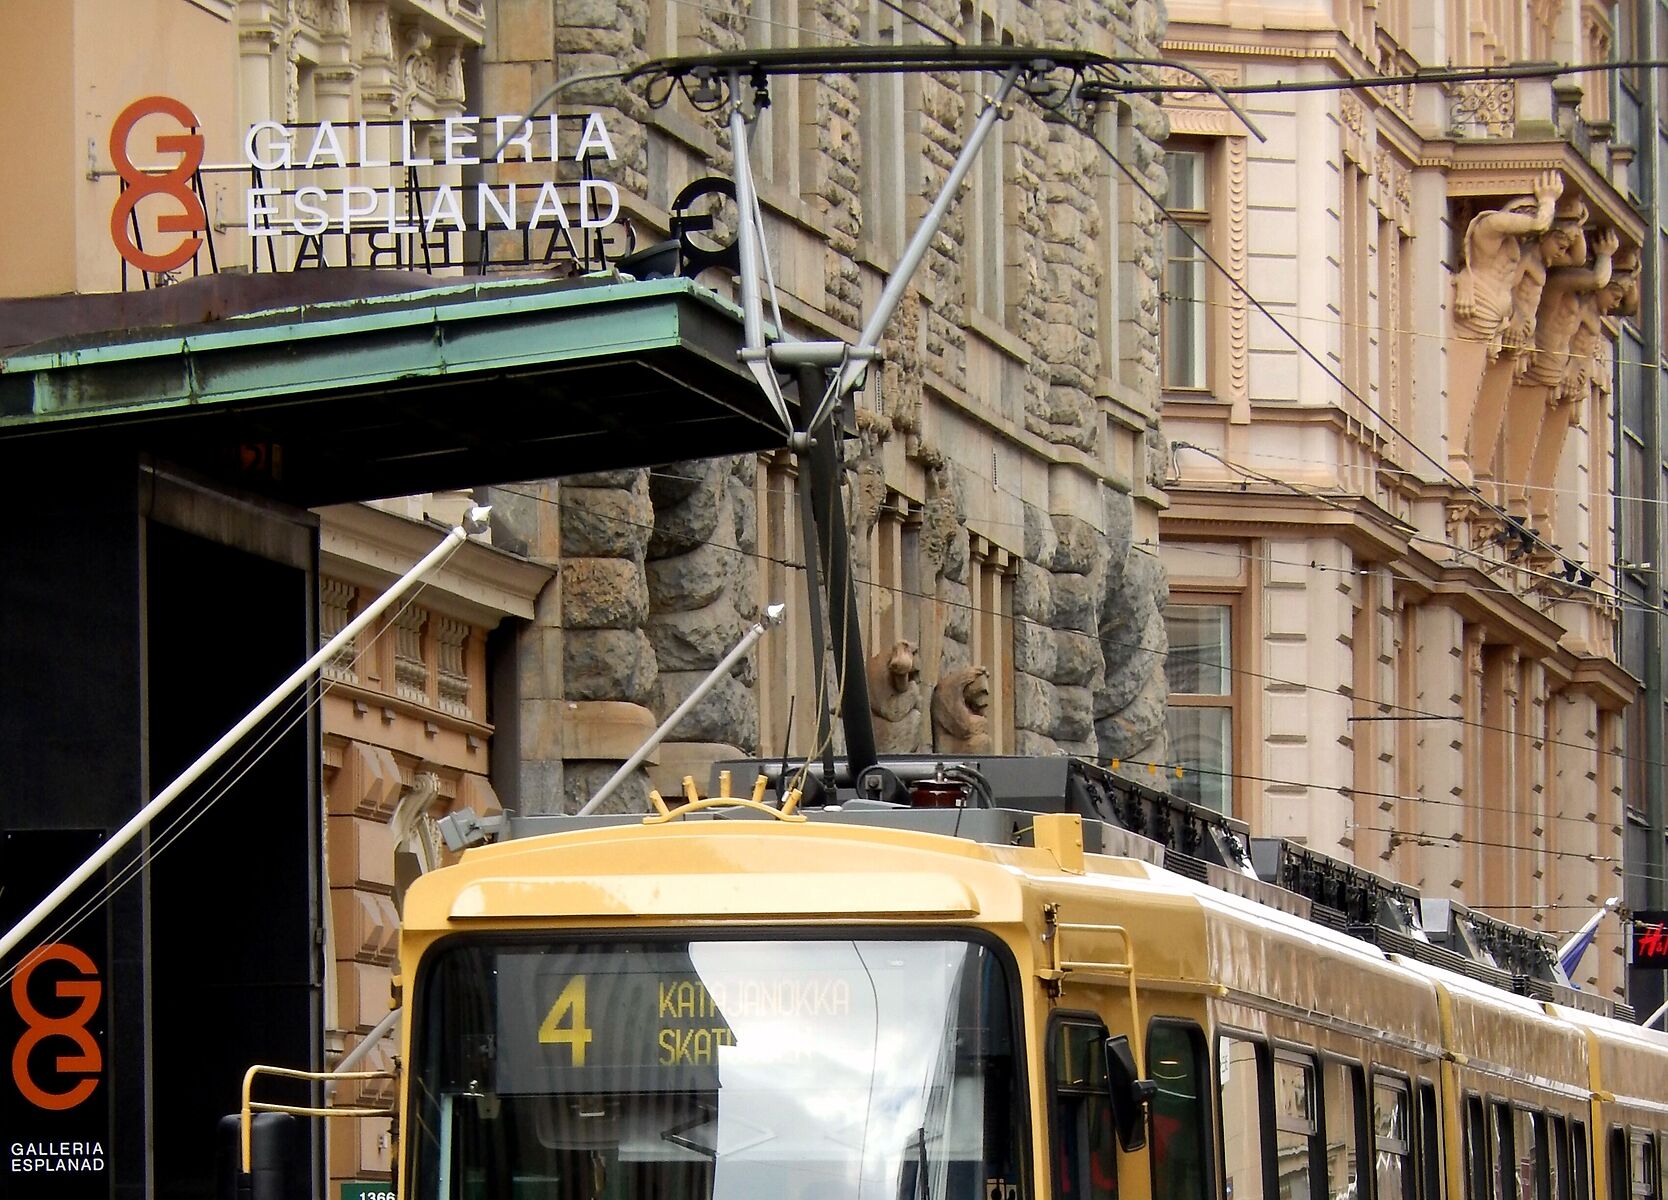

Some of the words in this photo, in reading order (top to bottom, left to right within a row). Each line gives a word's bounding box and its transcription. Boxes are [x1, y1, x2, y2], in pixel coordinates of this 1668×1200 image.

[244, 112, 619, 172] GALLERIA
[246, 178, 621, 237] ESPLANAD
[537, 974, 593, 1068] 4
[10, 1141, 104, 1156] GALLERIA
[10, 1157, 105, 1172] ESPLANAD
